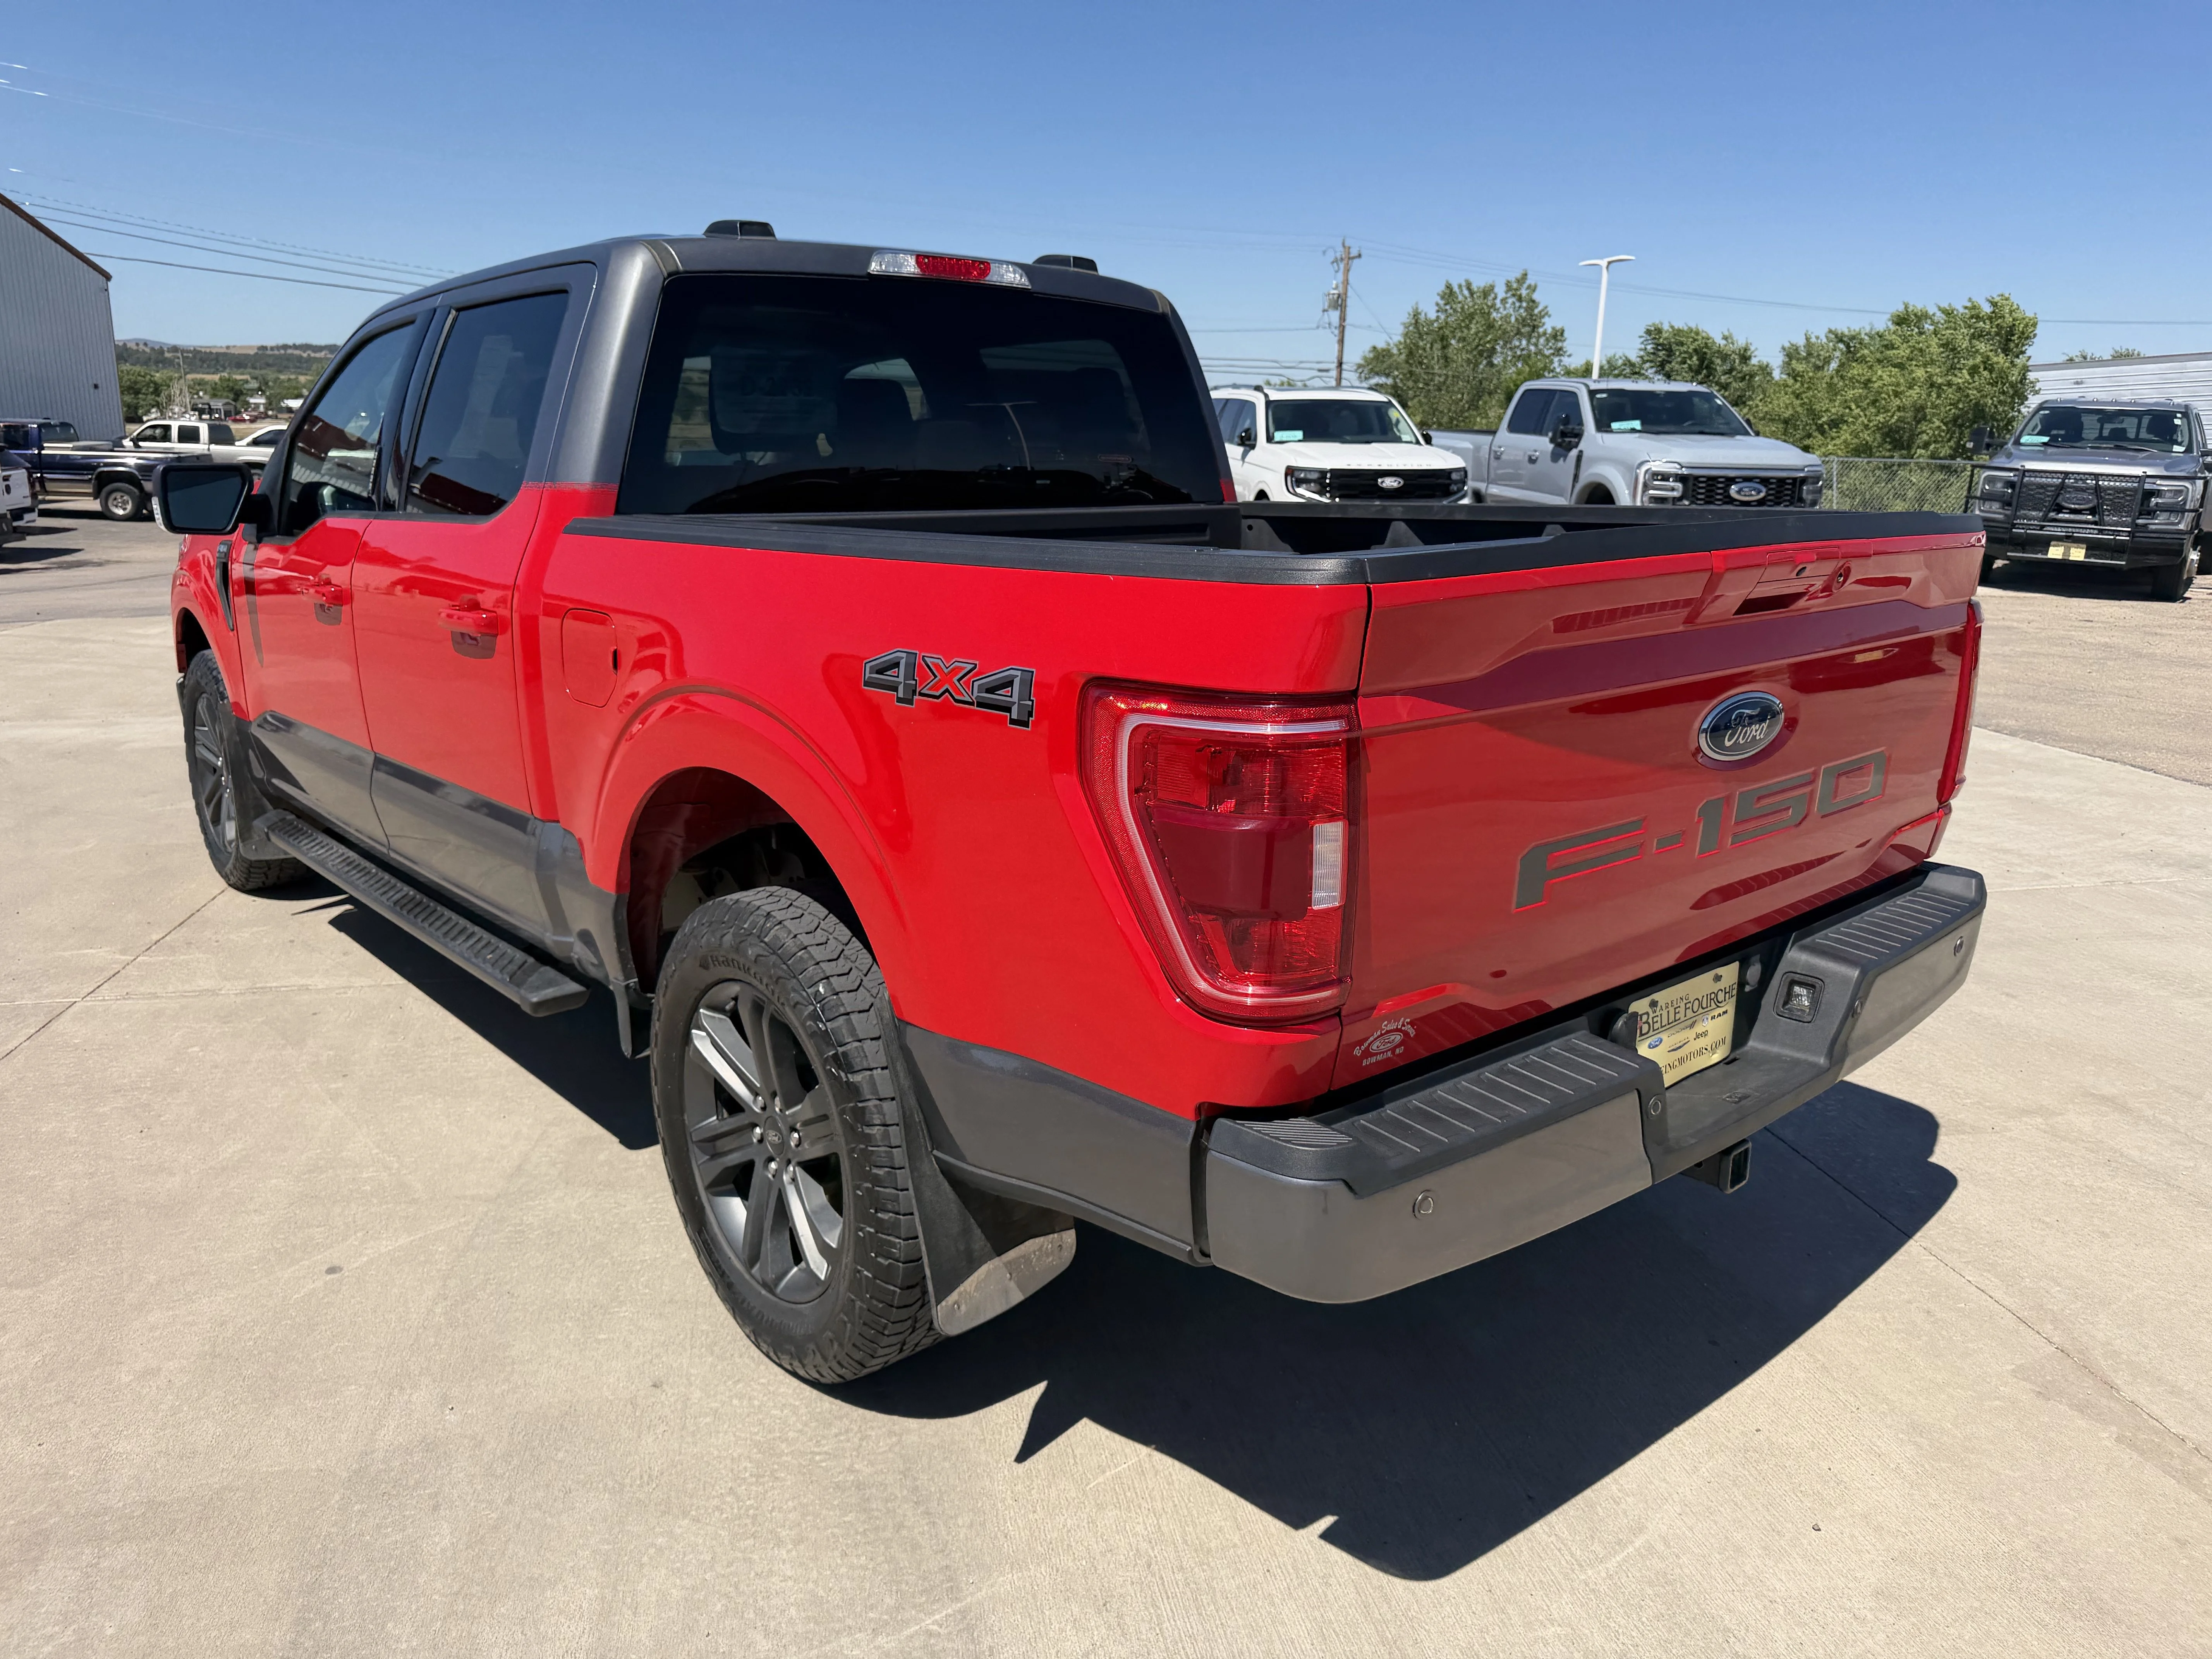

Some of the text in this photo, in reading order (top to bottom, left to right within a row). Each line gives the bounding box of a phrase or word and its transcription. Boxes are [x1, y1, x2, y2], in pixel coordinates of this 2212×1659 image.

[1724, 708, 1770, 747] Ford
[1514, 749, 1888, 912] F-150
[1638, 982, 1737, 1038] BELLE FOURCHE
[1652, 994, 1689, 1014] WAREING
[1710, 1010, 1728, 1021] RAM
[1353, 1030, 1381, 1056] Bowman
[1381, 1019, 1397, 1033] Sales
[1398, 1018, 1404, 1029] &
[1376, 1036, 1397, 1048] Ford
[1694, 1030, 1708, 1041] Jeep
[1395, 1046, 1404, 1055] ND
